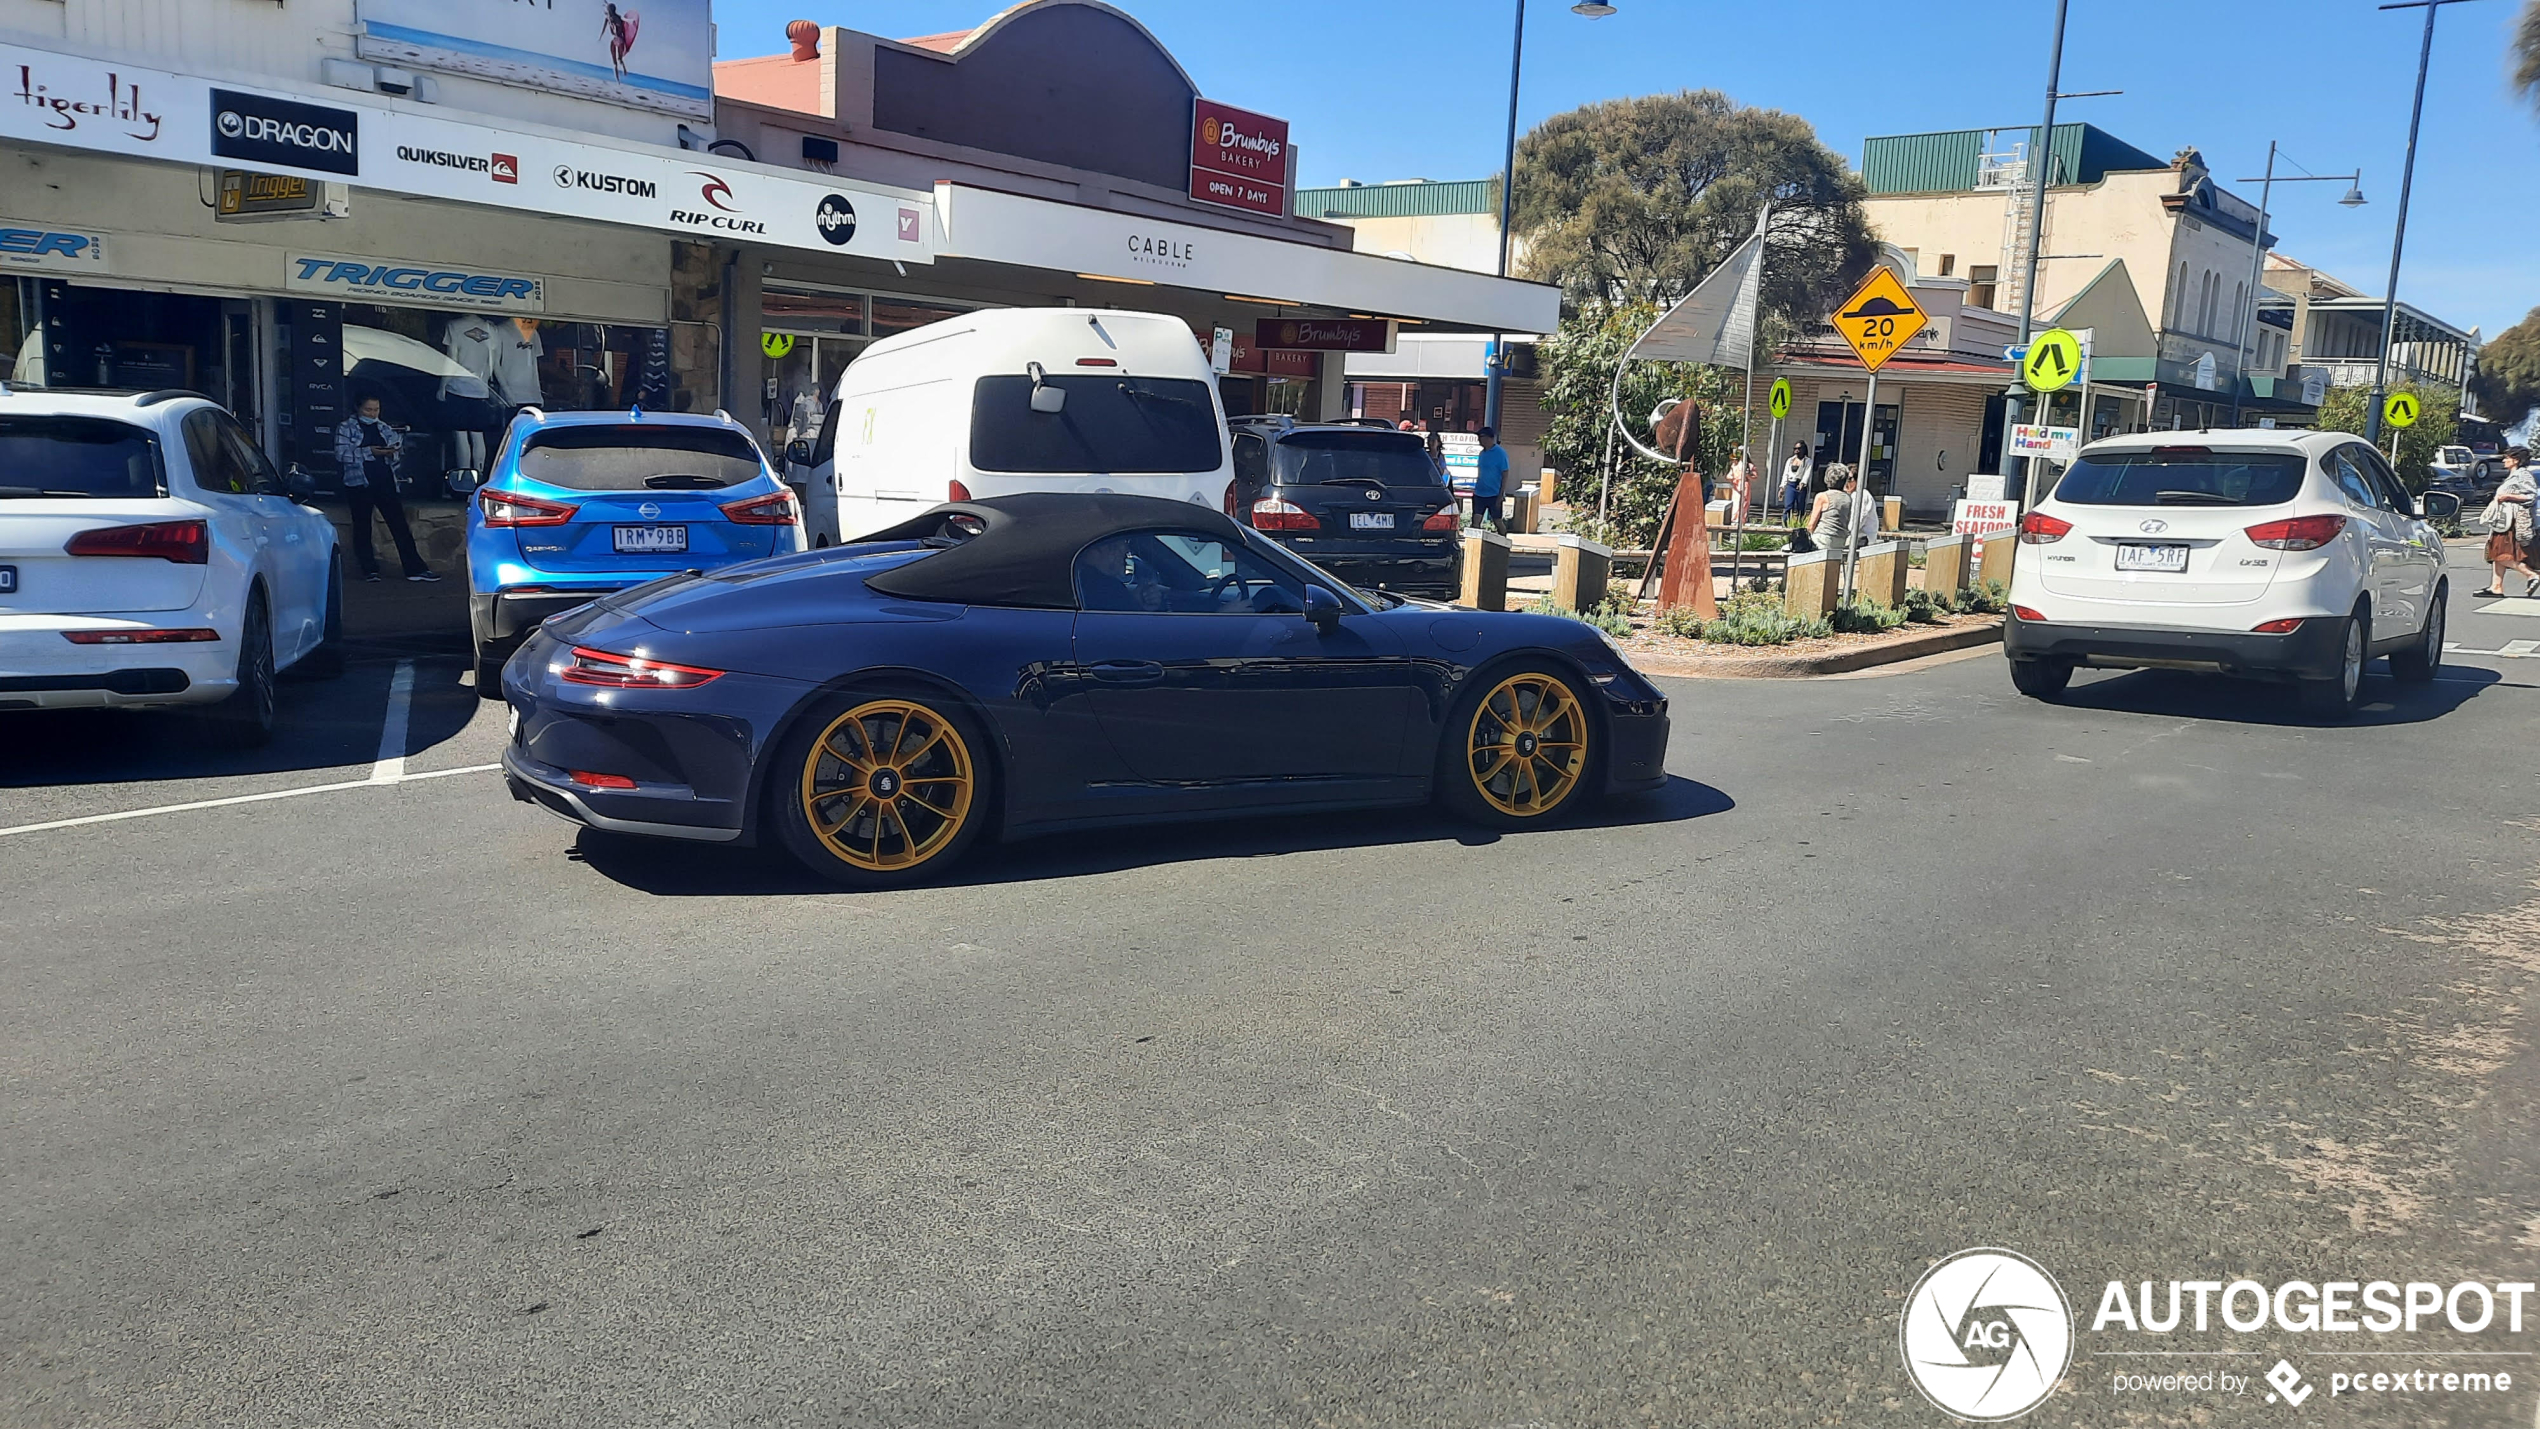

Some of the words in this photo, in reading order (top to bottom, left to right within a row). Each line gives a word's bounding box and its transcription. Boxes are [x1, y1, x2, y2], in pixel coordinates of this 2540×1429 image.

[14, 64, 162, 141] tigerlily
[245, 115, 352, 154] DRAGON
[1220, 122, 1280, 162] Brumby's
[397, 145, 489, 173] QUIKSILVER
[1221, 151, 1261, 169] BAKERY
[249, 173, 306, 199] Trigger
[577, 171, 656, 199] KUSTOM
[1209, 181, 1233, 196] OPEN
[1237, 186, 1243, 198] 7
[1247, 189, 1267, 204] DAYS
[670, 210, 709, 225] RIP
[711, 216, 767, 235] CURL
[817, 205, 855, 231] rhythm
[1128, 235, 1193, 261] CABLE
[296, 258, 534, 299] TRIGGER
[347, 287, 388, 296] RIDING
[390, 291, 440, 301] BOARDS
[443, 296, 476, 304] SINCE
[1298, 322, 1361, 347] Brumby's
[1863, 317, 1895, 338] 20
[1859, 338, 1893, 351] km/h
[1275, 352, 1307, 363] BAKERY
[2014, 438, 2052, 449] Hand
[2016, 426, 2049, 439] Hold
[2051, 431, 2073, 441] my
[1351, 516, 1369, 527] 1EL
[1966, 504, 2006, 519] FRESH
[617, 527, 645, 545] 1RM
[656, 529, 685, 545] 9BB
[2121, 547, 2145, 563] 1AF
[2157, 548, 2185, 563] 5RF
